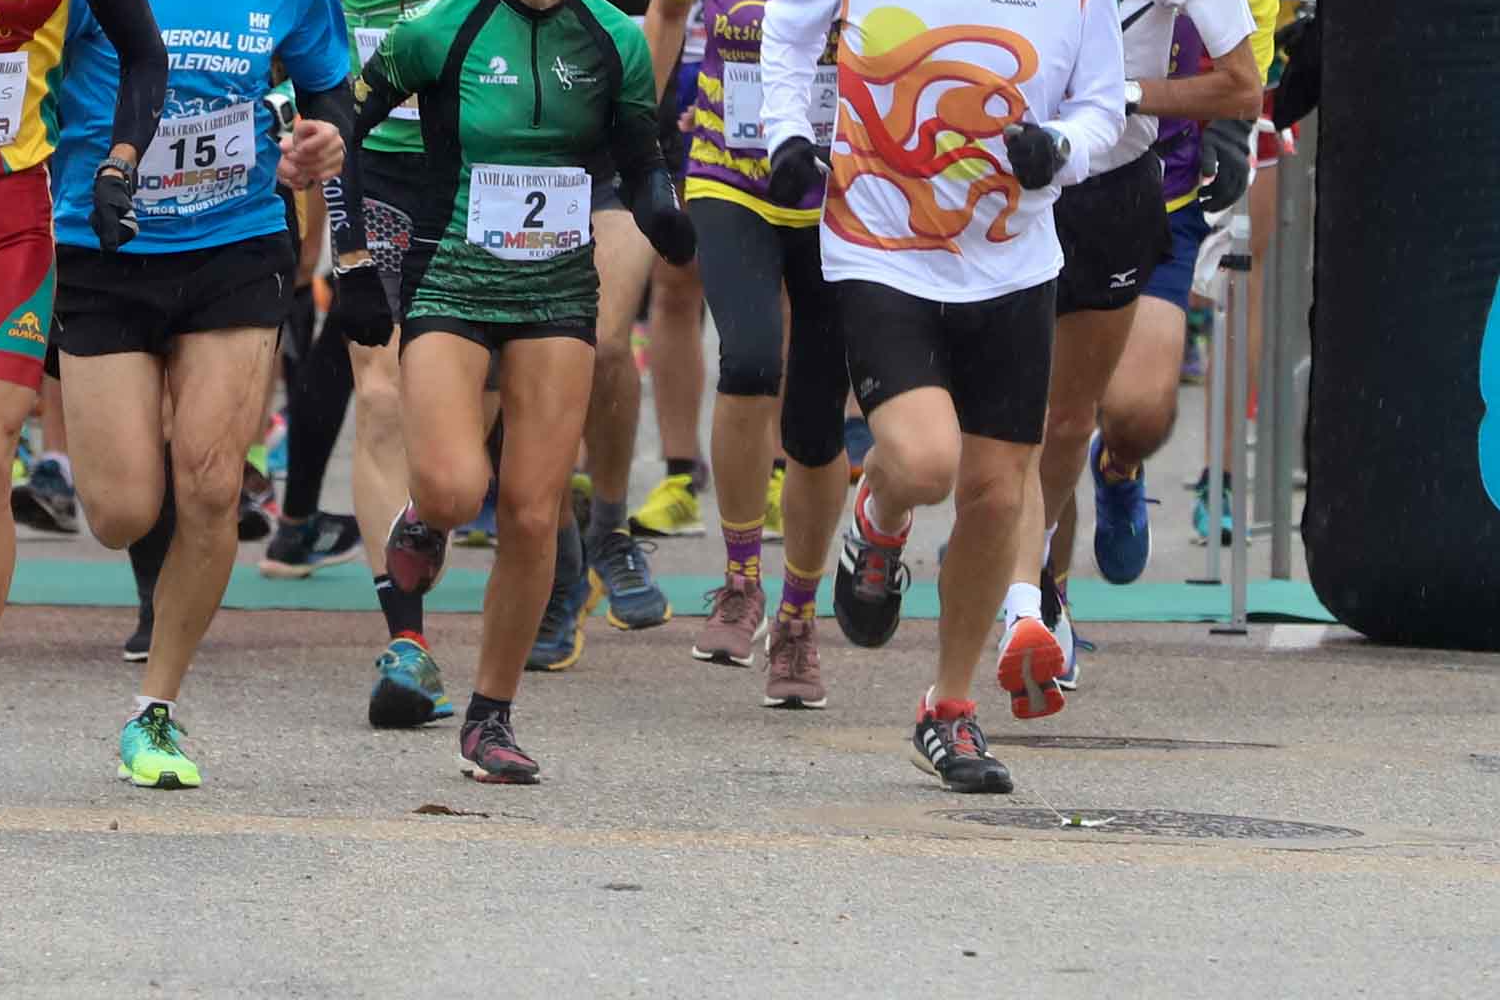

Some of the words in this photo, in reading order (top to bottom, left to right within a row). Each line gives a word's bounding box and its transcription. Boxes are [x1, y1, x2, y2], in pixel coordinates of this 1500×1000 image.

[237, 34, 273, 53] ULSA
[168, 53, 250, 75] TLETISMO
[169, 134, 216, 170] 15
[178, 188, 248, 215] INDUSTRIALES
[523, 191, 547, 228] 2
[476, 230, 582, 249] JOMISAGA
